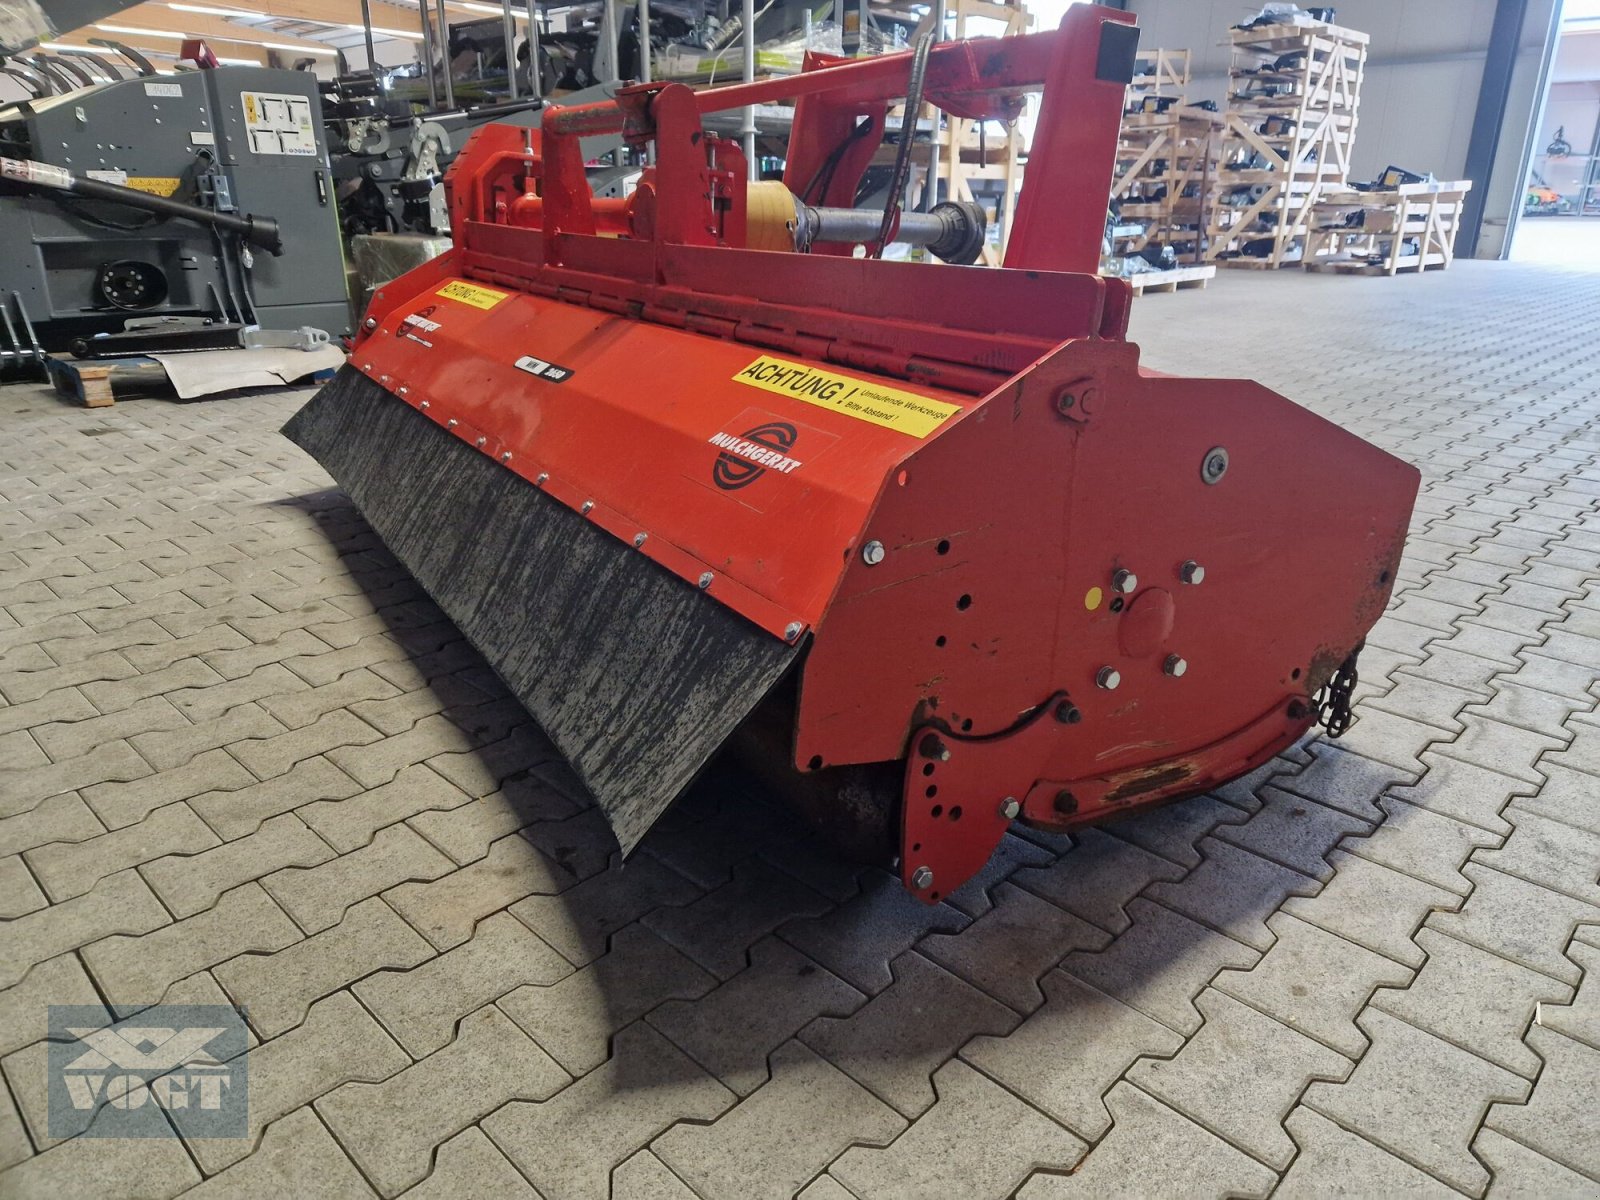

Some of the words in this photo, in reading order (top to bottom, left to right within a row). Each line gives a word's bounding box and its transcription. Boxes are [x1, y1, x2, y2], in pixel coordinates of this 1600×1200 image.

[741, 362, 844, 400] ACHTUNG
[844, 401, 862, 411] Bitte
[862, 406, 894, 421] Abstand
[860, 389, 904, 407] Umlaufende
[904, 401, 948, 420] Werkzeuge
